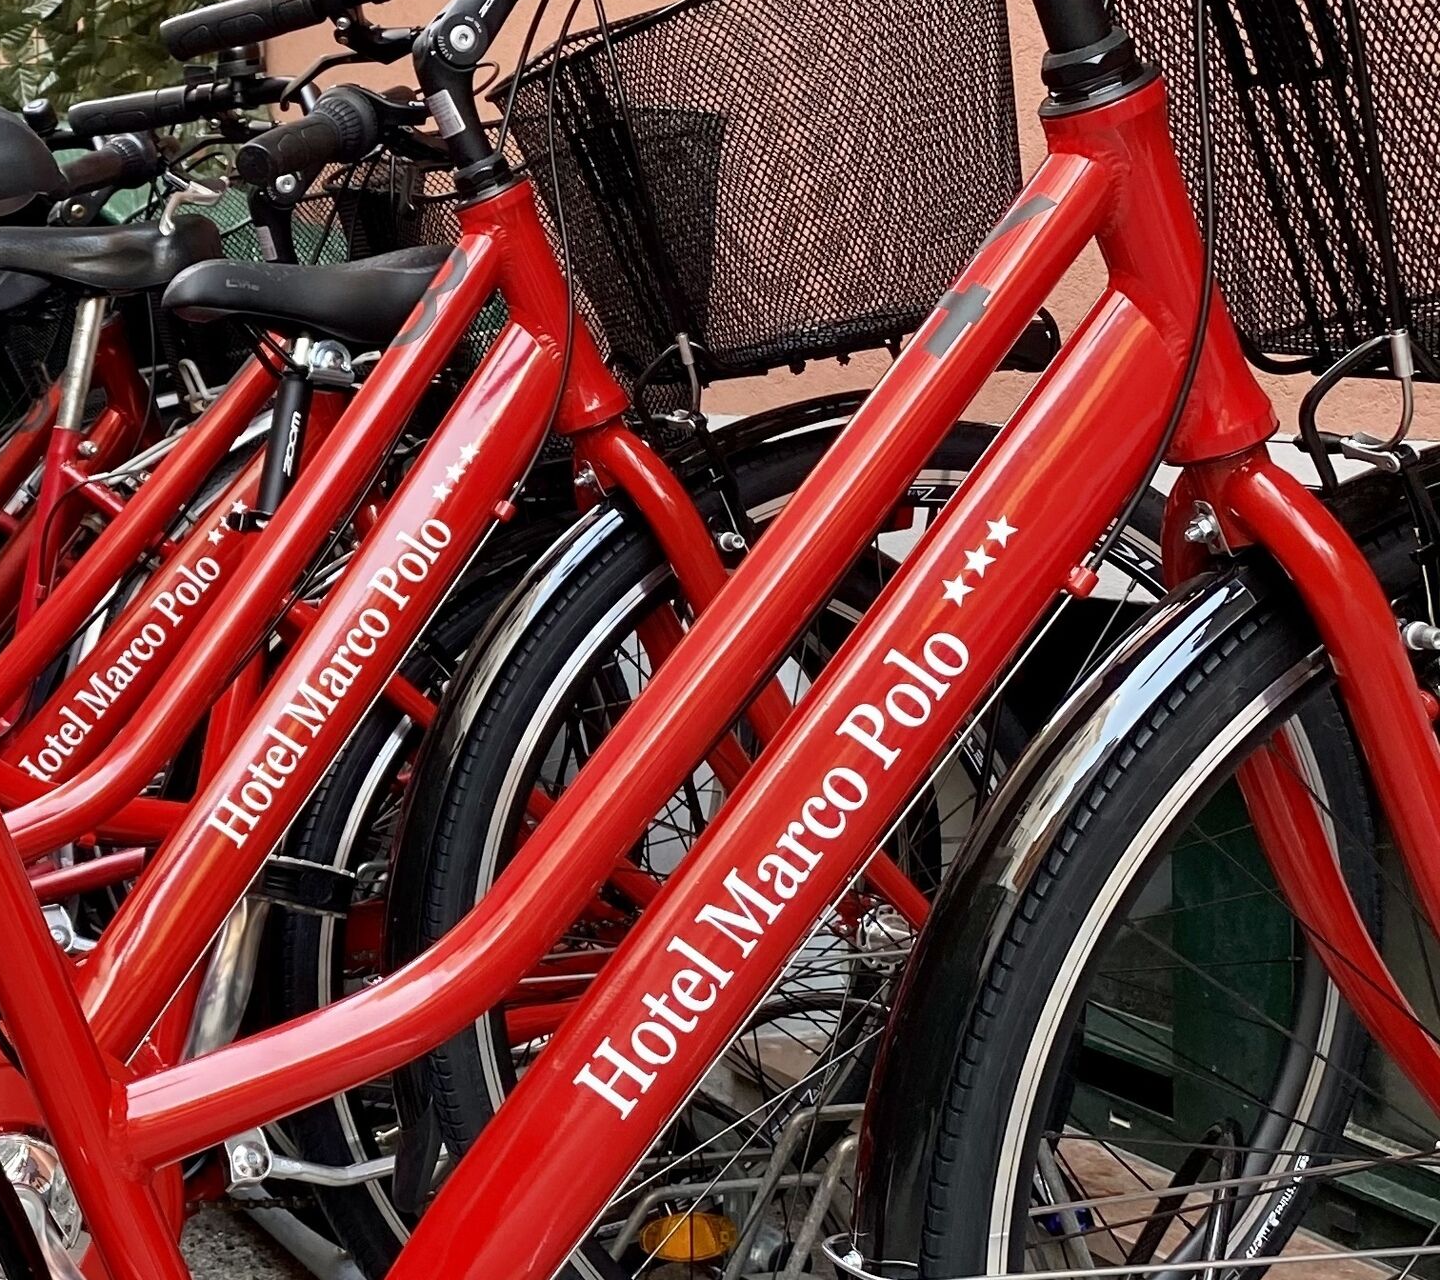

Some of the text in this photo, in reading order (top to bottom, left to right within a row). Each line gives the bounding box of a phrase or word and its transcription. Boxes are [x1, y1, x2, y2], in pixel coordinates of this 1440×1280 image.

[74, 624, 166, 720] Marco
[151, 554, 221, 629] Polo
[204, 519, 453, 849] Hotel Marco Polo
[572, 631, 969, 1122] Hotel Marco Polo
